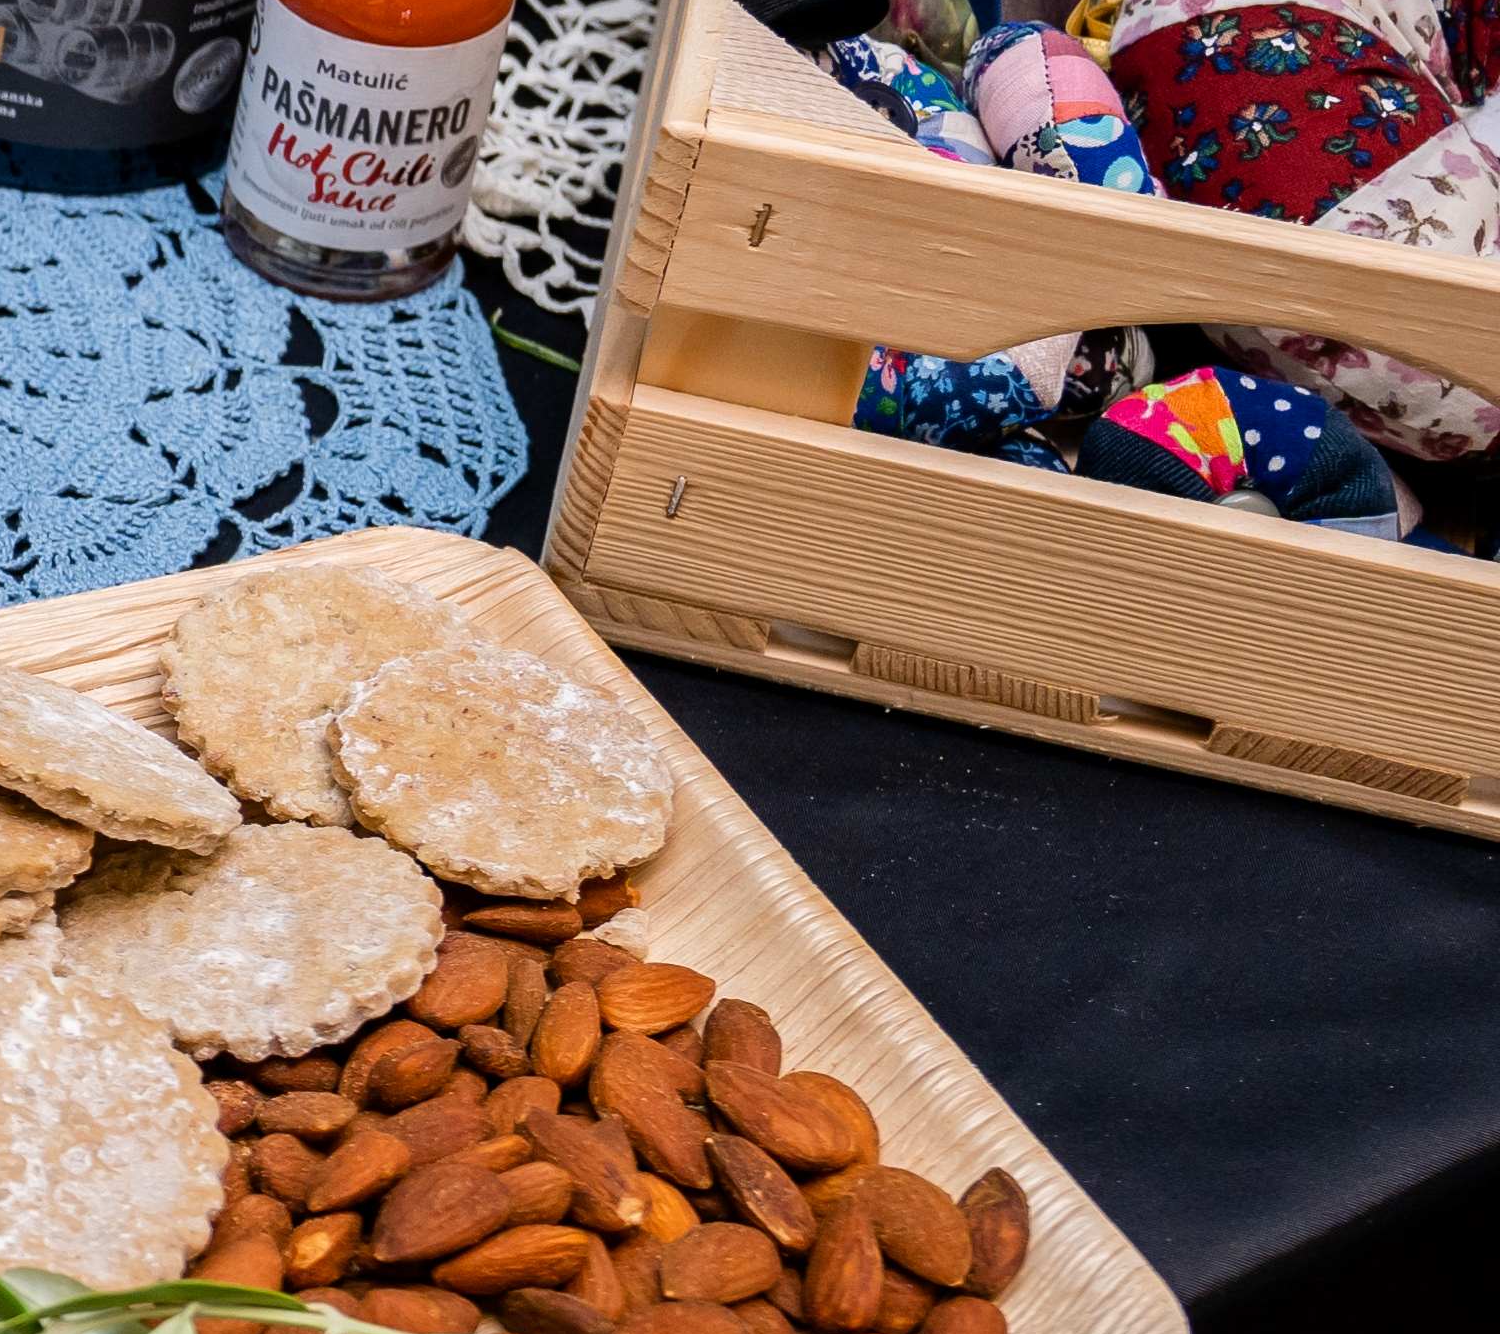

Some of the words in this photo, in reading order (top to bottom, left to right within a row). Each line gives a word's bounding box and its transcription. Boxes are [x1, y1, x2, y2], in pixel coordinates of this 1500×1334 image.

[317, 59, 409, 90] Matulić
[262, 64, 471, 146] PAŠMANERO
[267, 122, 336, 174] Hot
[342, 151, 437, 187] Chili
[308, 172, 396, 213] Sauce
